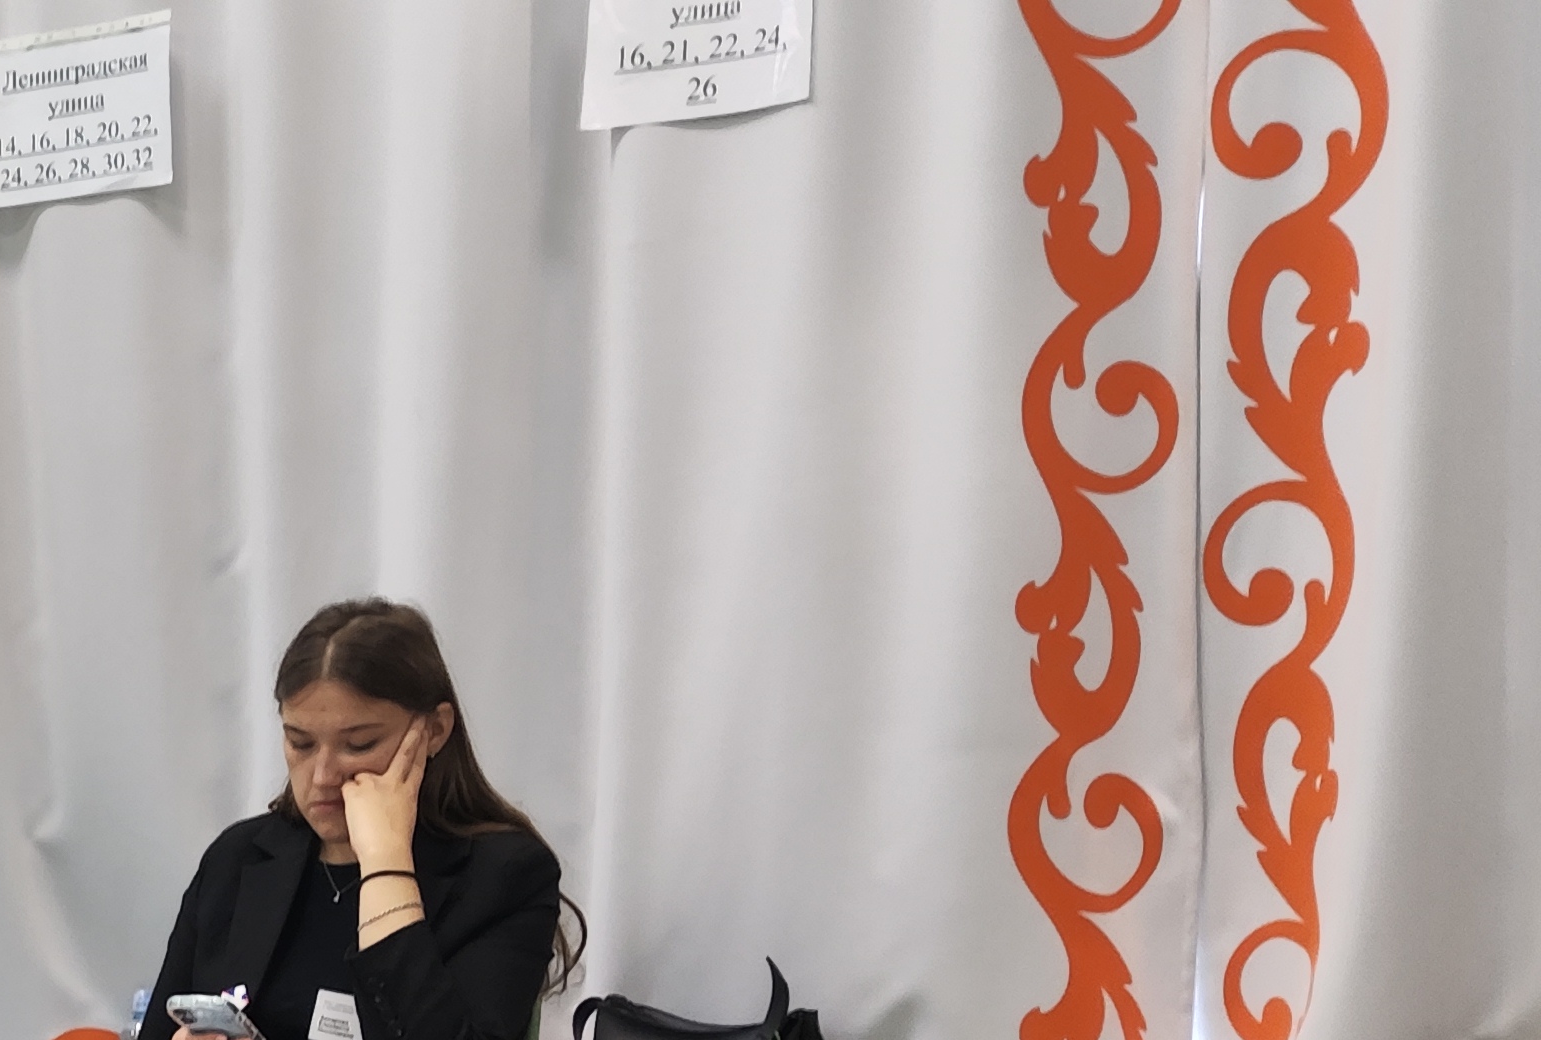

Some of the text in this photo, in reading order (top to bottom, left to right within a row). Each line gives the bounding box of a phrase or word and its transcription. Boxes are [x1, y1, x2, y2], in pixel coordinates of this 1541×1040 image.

[619, 24, 787, 70] 16, 21, 22, 24,
[2, 53, 148, 92] Ленинградская
[688, 75, 717, 100] 26
[48, 93, 105, 120] улица
[31, 131, 56, 152] 16,
[65, 125, 90, 147] 18,
[97, 120, 125, 141] 20,
[131, 114, 158, 137] 22,
[0, 167, 28, 189] 24,
[35, 161, 62, 183] 26,
[68, 156, 96, 178] 28,
